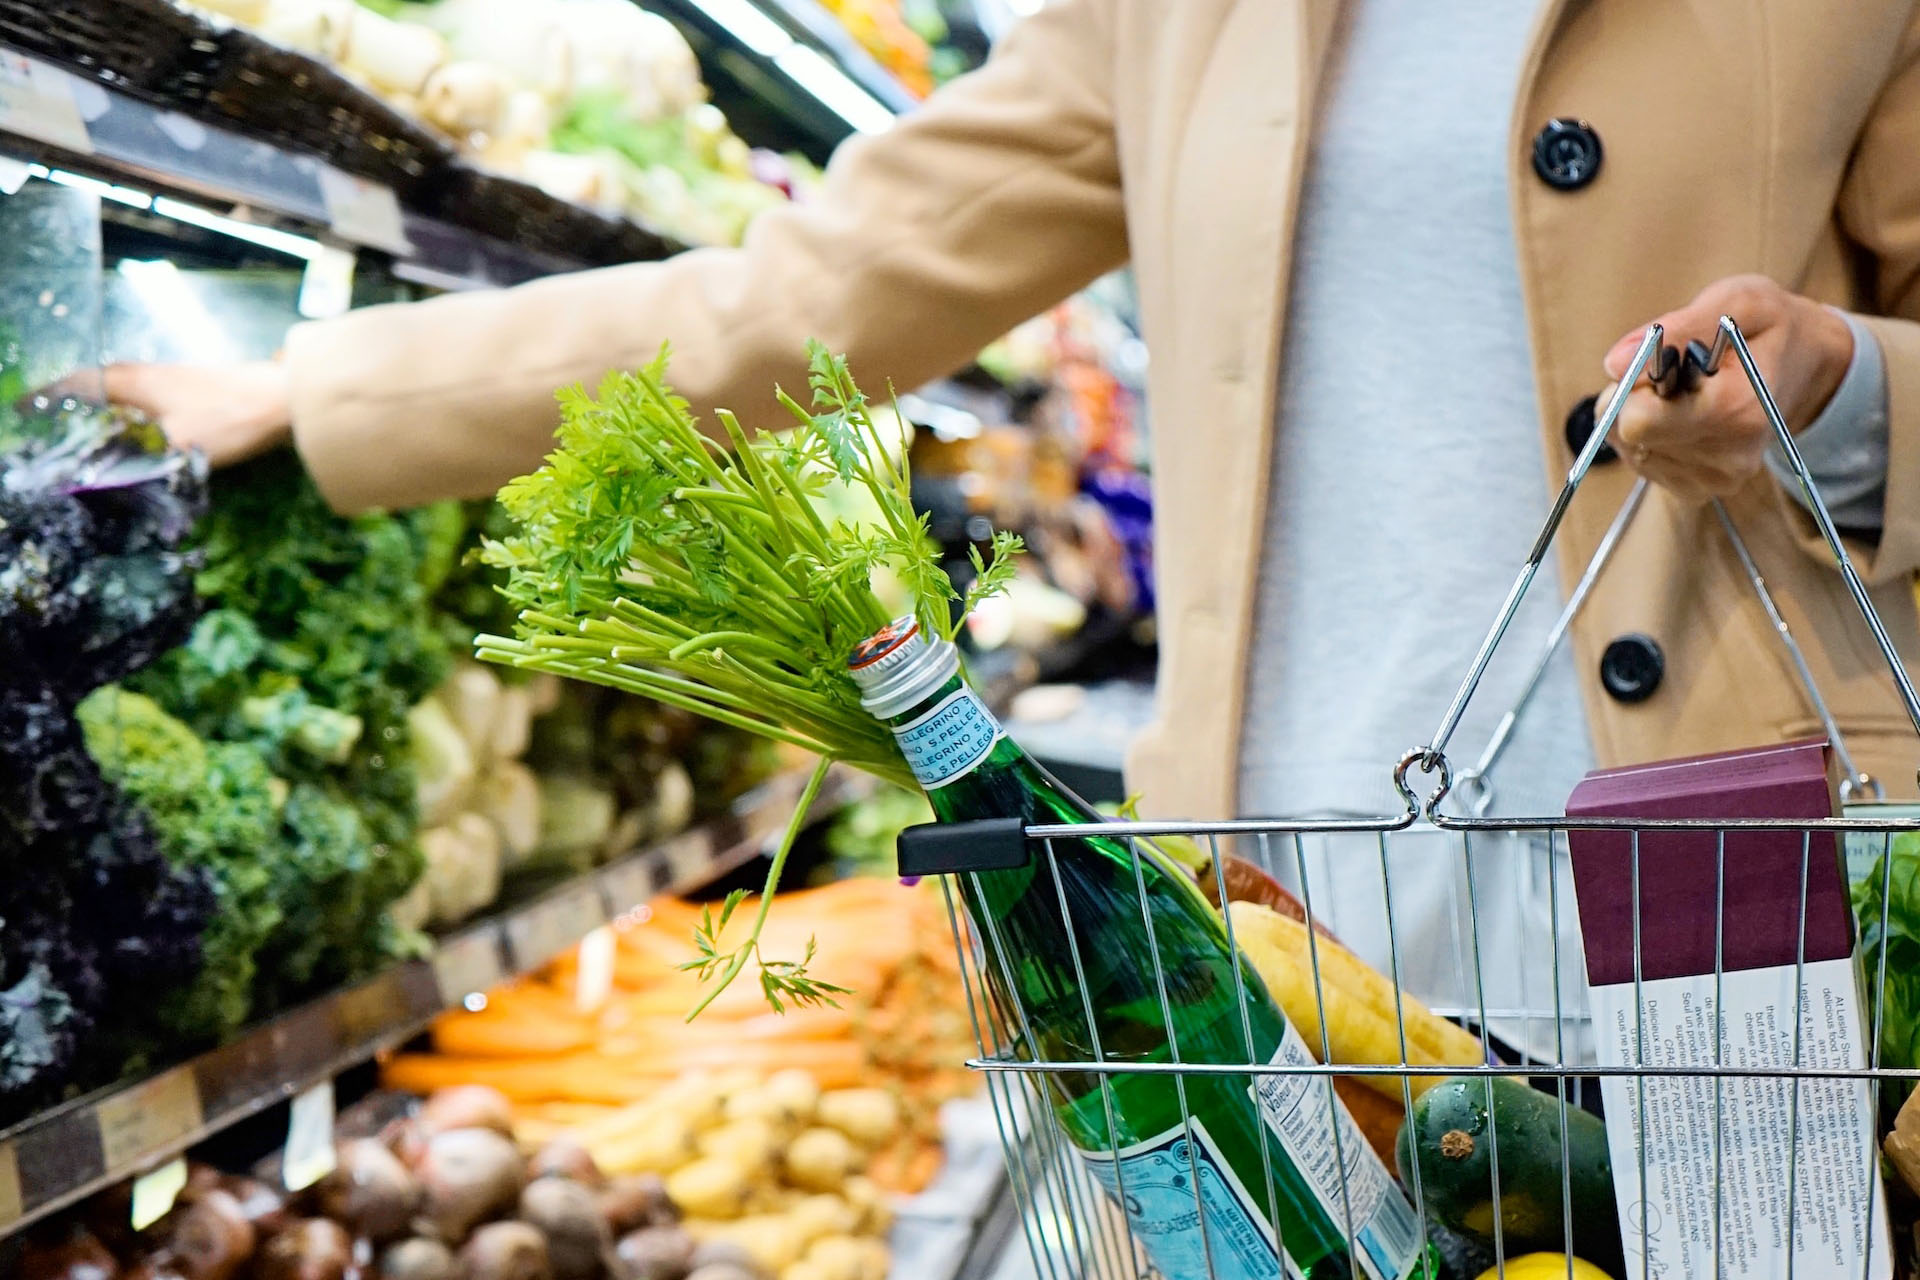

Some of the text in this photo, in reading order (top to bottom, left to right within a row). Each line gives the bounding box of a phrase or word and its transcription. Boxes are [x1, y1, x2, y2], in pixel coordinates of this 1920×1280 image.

[1682, 991, 1693, 1013] Seul
[1704, 996, 1714, 1008] de
[1822, 987, 1835, 1029] delicious
[1834, 995, 1844, 1006] At
[1616, 1009, 1626, 1031] vous
[1647, 999, 1661, 1041] Délicieux
[1685, 1016, 1693, 1027] un
[1694, 1006, 1704, 1027] avec
[1755, 1012, 1764, 1026] but
[1765, 1005, 1776, 1031] these
[1835, 1009, 1848, 1039] Lesley
[1620, 1034, 1628, 1045] ne
[1756, 1029, 1768, 1053] really
[1780, 1030, 1789, 1038] A
[1805, 1026, 1814, 1041] her
[1638, 1017, 1654, 1082] accompags
[1654, 1045, 1661, 1056] au
[1675, 1024, 1688, 1067] supérieu
[1686, 1030, 1698, 1062] produit
[1721, 1043, 1732, 1066] Stow
[1768, 1033, 1779, 1065] unique
[1781, 1040, 1793, 1073] CRIS
[1808, 1044, 1817, 1068] team
[1818, 1039, 1826, 1054] are
[1840, 1042, 1852, 1069] Stow
[1620, 1049, 1633, 1084] pouz
[1701, 1055, 1709, 1066] en
[1737, 1047, 1747, 1067] sna
[1692, 1064, 1703, 1098] aison
[1799, 1061, 1809, 1081] frm
[1820, 1057, 1831, 1083] mae
[1831, 1056, 1843, 1085] The
[1626, 1086, 1636, 1104] plus
[1649, 1085, 1657, 1096] de
[1681, 1076, 1694, 1109] pouvait
[1704, 1075, 1715, 1099] etites
[1774, 1077, 1786, 1107] ackers
[1811, 1076, 1821, 1093] ink
[1824, 1086, 1834, 1104] with
[1845, 1078, 1855, 1095] ine
[1661, 1096, 1669, 1112] ces
[1765, 1084, 1775, 1108] when
[1802, 1085, 1813, 1117] scratch
[1815, 1096, 1823, 1110] the
[1729, 1098, 1740, 1126] Foods
[1746, 1109, 1754, 1124] are
[1779, 1110, 1787, 1124] are
[1827, 1107, 1835, 1128] care
[1835, 1088, 1848, 1127] fabulous
[1847, 1098, 1859, 1127] Foods
[1694, 1101, 1709, 1138] fabriqué
[1744, 1012, 1781, 1247] cheese or apasto. We are addicted to this yummy
[1767, 1112, 1779, 1143] topped
[1815, 1114, 1826, 1132] only
[1662, 1115, 1676, 1162] craquelins
[1664, 1038, 1699, 1241] CRAEZ POUR CES FINS CRAQUELINS
[1687, 1112, 1700, 1153] satisfaire
[1721, 1118, 1733, 1156] fabuleux
[1733, 1129, 1744, 1155] adore
[1748, 1128, 1757, 1147] sure
[1805, 1120, 1816, 1145] using
[1830, 1131, 1838, 1139] in
[1839, 1130, 1851, 1157] crisps
[1852, 1130, 1859, 1143] we
[1658, 1148, 1665, 1159] de
[1702, 1141, 1711, 1162] avec
[1773, 1145, 1782, 1163] with
[1818, 1135, 1827, 1153] way
[1831, 1142, 1842, 1166] small
[1854, 1146, 1864, 1164] love
[1750, 1150, 1759, 1166] you
[1822, 1157, 1829, 1165] to
[1657, 1162, 1671, 1200] fromage
[1671, 1165, 1680, 1184] sont
[1693, 1156, 1704, 1185] Lesley
[1705, 1165, 1714, 1183] des
[1736, 1159, 1749, 1198] fabriquer
[1754, 1170, 1763, 1183] will
[1775, 1167, 1784, 1186] your
[1813, 1165, 1822, 1190] finest
[1824, 1168, 1834, 1193] make
[1845, 1160, 1855, 1181] from
[1698, 1188, 1706, 1196] et
[1725, 1159, 1740, 1206] craquelins
[1757, 1186, 1765, 1198] be
[1855, 1168, 1868, 1201] making
[1665, 1203, 1671, 1214] ou
[1673, 1187, 1687, 1238] irrésistibles
[1699, 1200, 1707, 1216] son
[1743, 1202, 1751, 1210] et
[1845, 1184, 1860, 1221] Lesley's
[1724, 1221, 1732, 1232] de
[1733, 1209, 1743, 1228] sont
[1744, 1214, 1753, 1233] vous
[1826, 1205, 1838, 1228] great
[1795, 1233, 1804, 1251] own
[1830, 1231, 1843, 1265] product
[1853, 1223, 1864, 1256] kitchen
[1734, 1232, 1748, 1273] fabriqués
